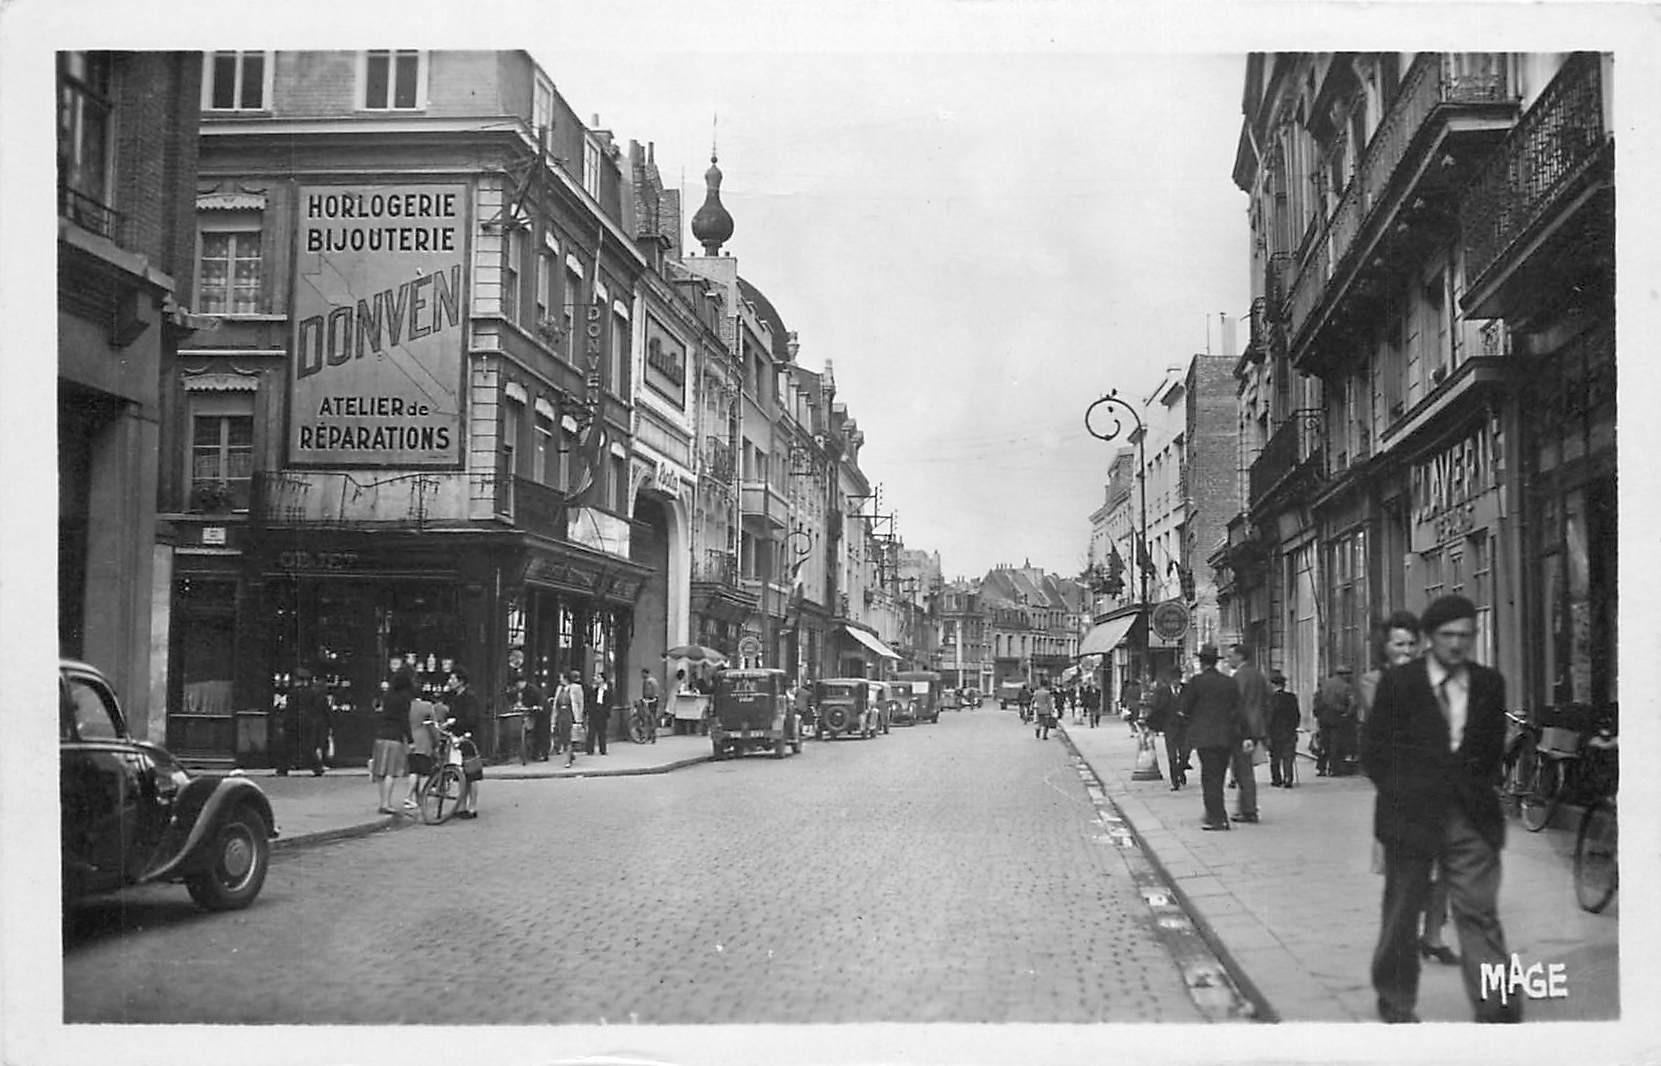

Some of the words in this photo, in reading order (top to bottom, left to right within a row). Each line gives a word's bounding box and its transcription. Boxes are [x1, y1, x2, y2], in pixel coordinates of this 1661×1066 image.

[308, 193, 456, 219] HORLOGERIE
[307, 227, 455, 252] BIJOUTERIE
[297, 264, 461, 380] DONVEN
[587, 306, 602, 404] DONVEN
[319, 397, 403, 416] ATELIER
[406, 401, 429, 416] de
[300, 421, 450, 450] RÉPARATIONS
